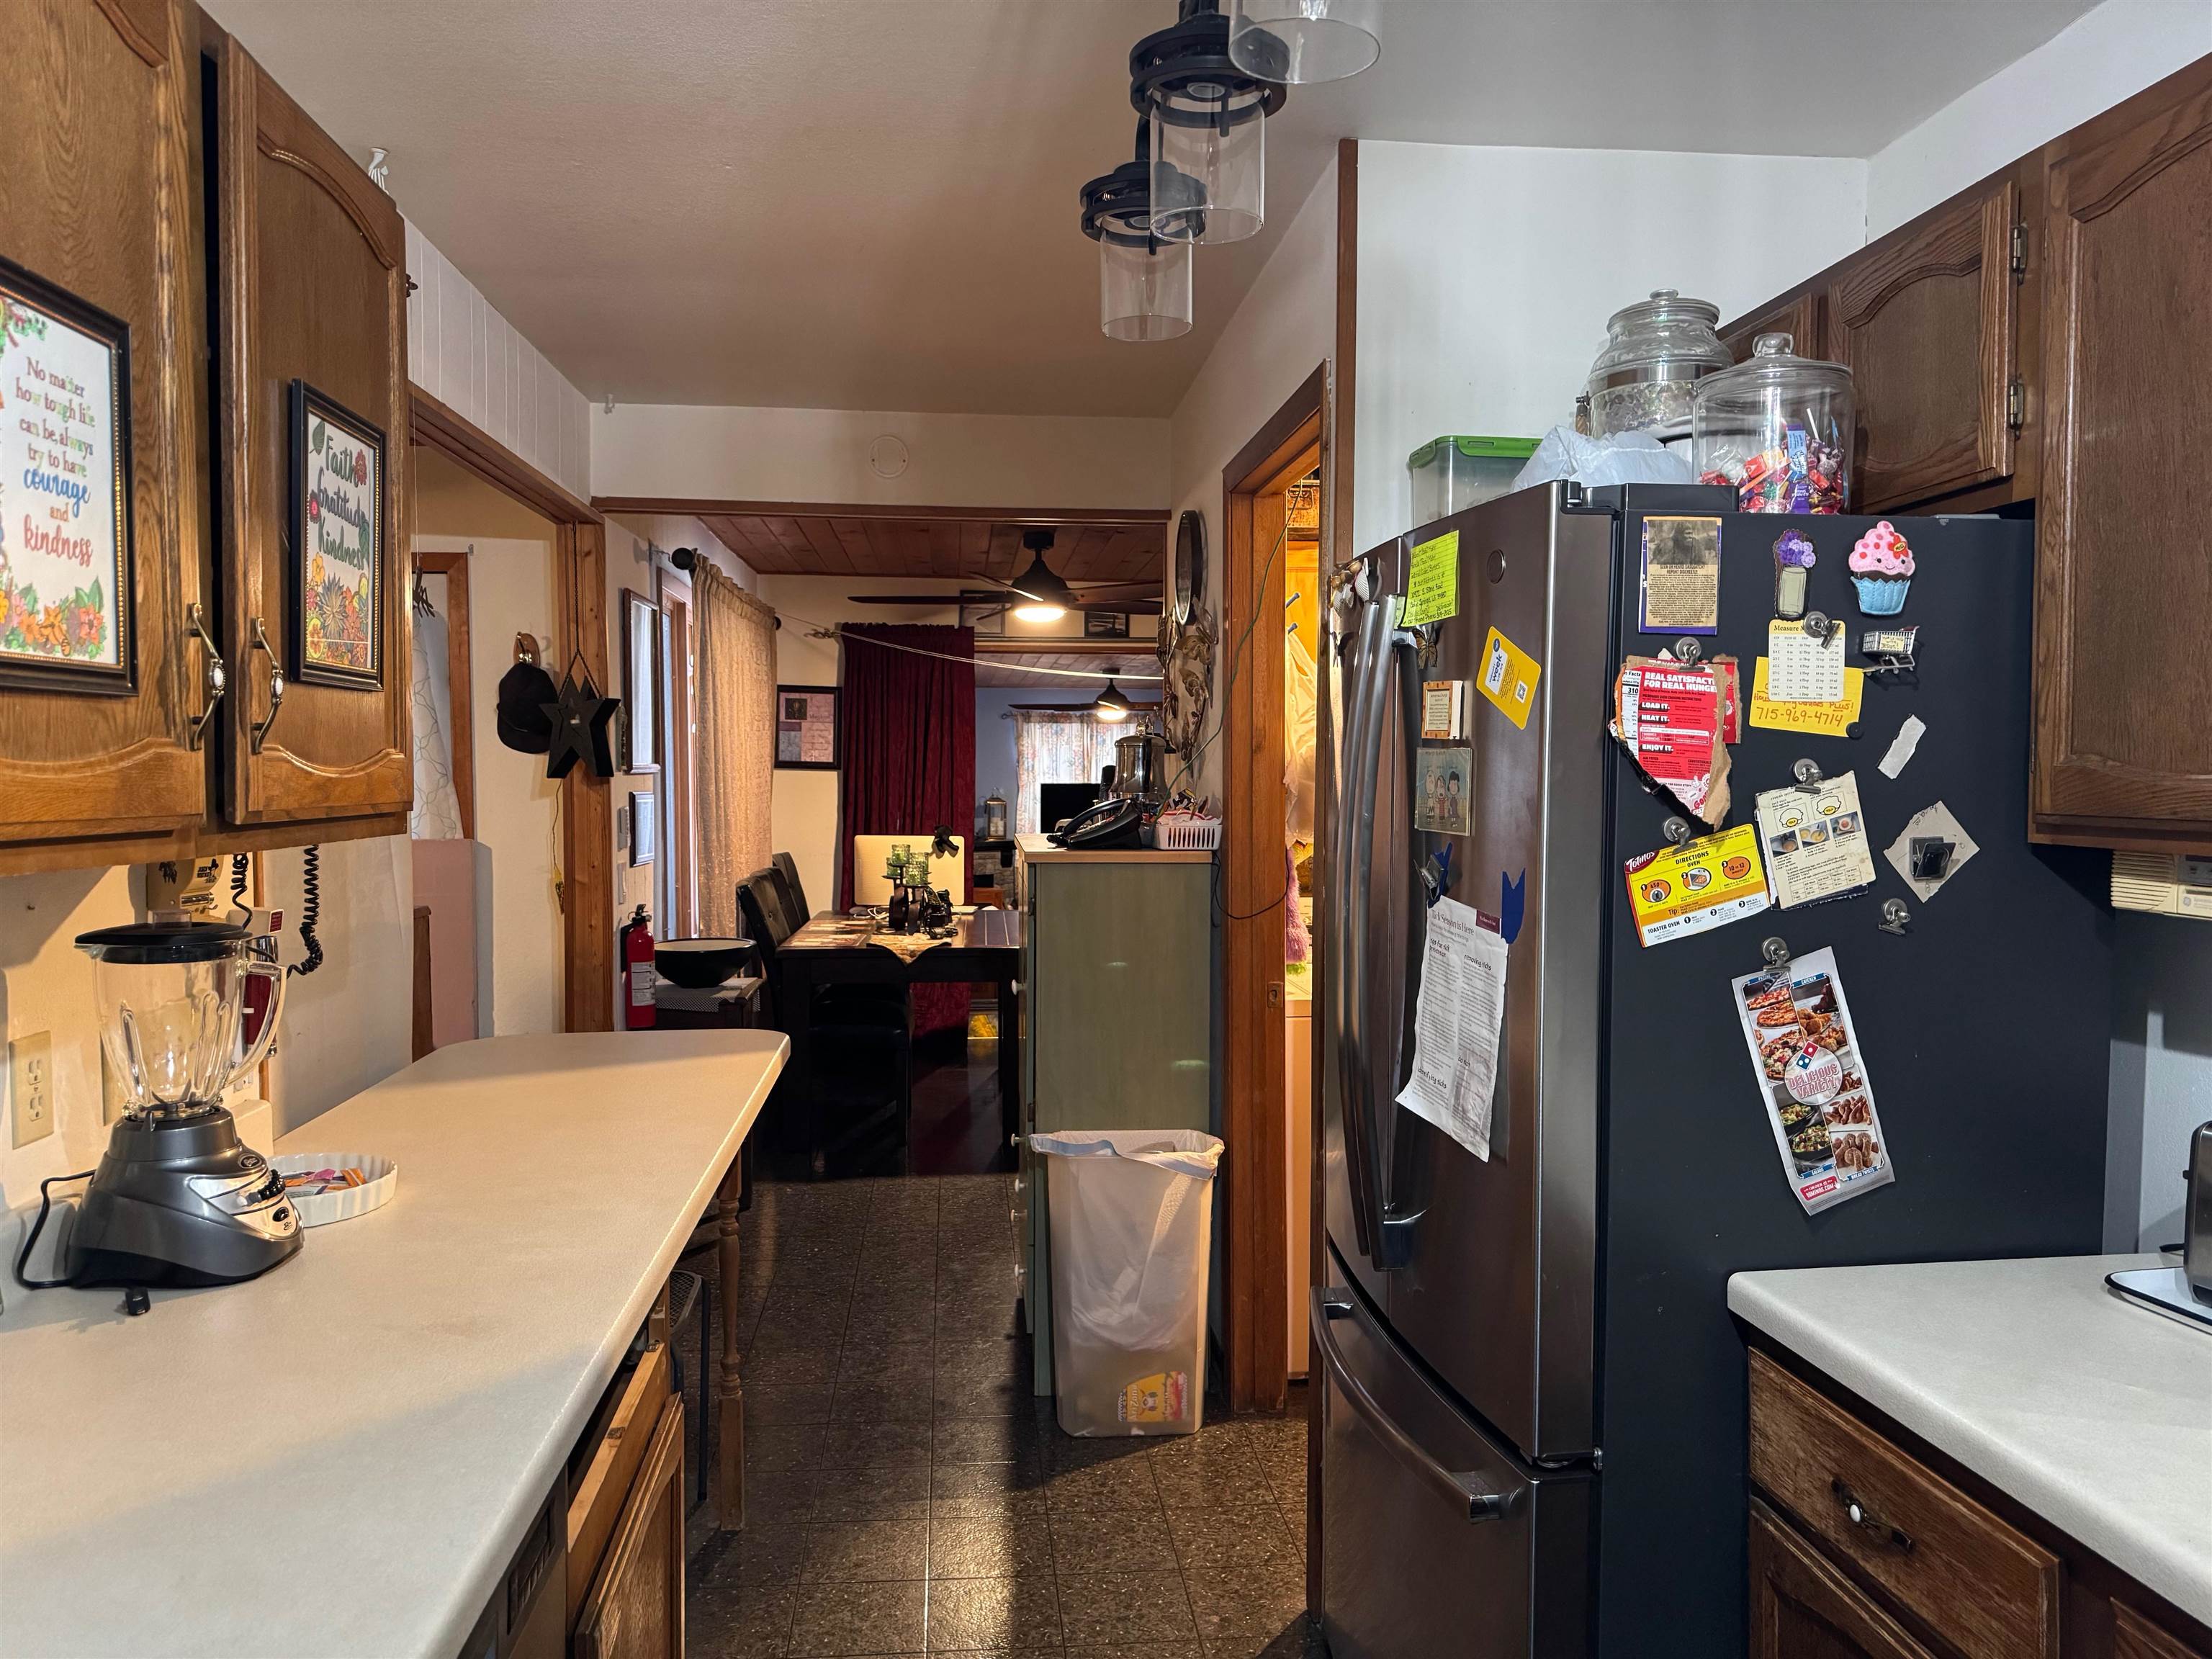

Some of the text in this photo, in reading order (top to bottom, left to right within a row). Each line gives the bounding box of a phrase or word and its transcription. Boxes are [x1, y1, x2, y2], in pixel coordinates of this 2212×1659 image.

[27, 356, 45, 381] No
[16, 377, 95, 427] how tough life
[20, 418, 40, 436] can
[59, 426, 93, 460] always
[28, 443, 87, 477] try to have
[325, 434, 359, 487] Faith
[24, 468, 91, 518] courage
[50, 502, 69, 522] and
[24, 513, 93, 567] kindness
[1492, 654, 1502, 682] week
[1645, 672, 1666, 681] REAL
[1644, 679, 1660, 688] FOR
[1662, 681, 1685, 689] REAL
[1757, 706, 1844, 727] 715-969-4714
[1675, 851, 1709, 865] DIRECTIONS
[1431, 909, 1440, 921] Tick
[1441, 914, 1457, 929] Season
[1462, 922, 1474, 936] Here
[1668, 907, 1680, 916] Tip:
[1647, 925, 1667, 934] TOASTER
[1464, 954, 1492, 971] removing ticks
[1801, 976, 1817, 984] CHICKEN
[1789, 1064, 1839, 1089] DELICIOUS
[1797, 1076, 1836, 1099] VARIETY
[1806, 1182, 1834, 1198] DOMINOS.COM
